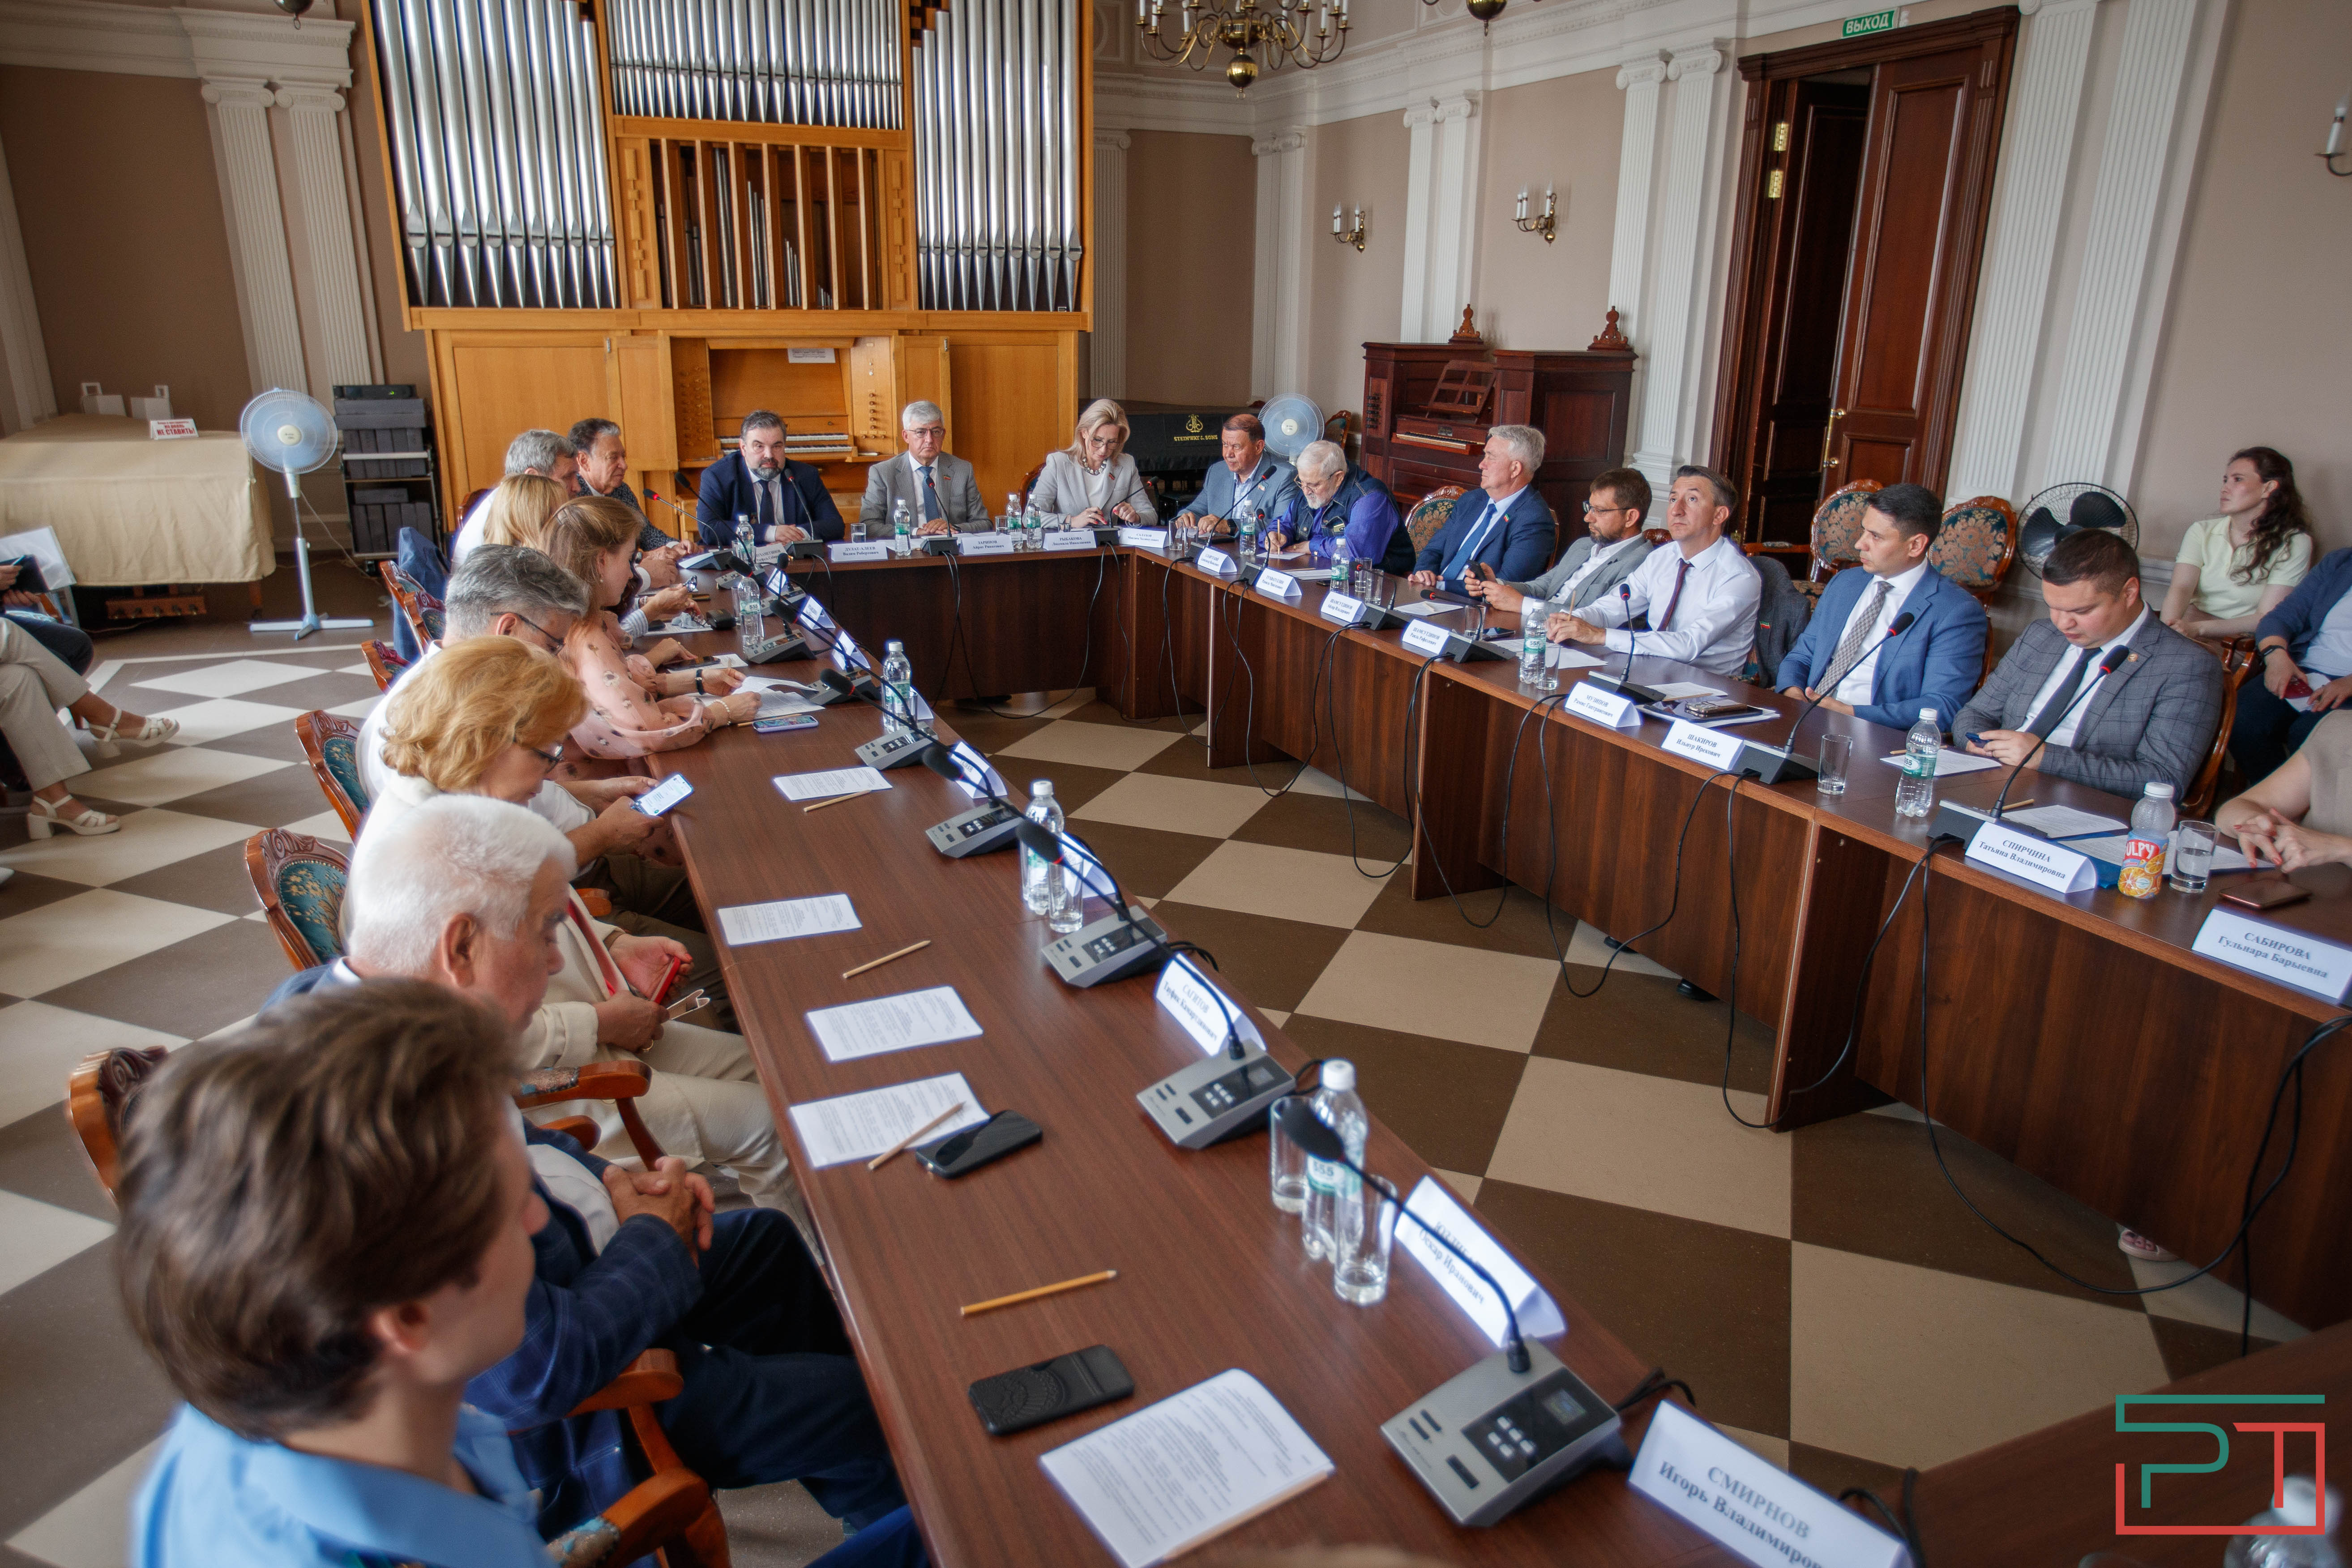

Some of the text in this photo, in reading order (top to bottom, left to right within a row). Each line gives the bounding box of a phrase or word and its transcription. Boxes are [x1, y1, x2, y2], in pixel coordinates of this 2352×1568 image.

[1846, 13, 1889, 34] ВЫХОД
[166, 427, 196, 435] СТАВИТЬ!
[1676, 739, 1721, 758] Ильнур Ирекович
[1687, 733, 1718, 748] ШАКИРОВ
[1978, 841, 2066, 880] Татьяна Владимировна
[2002, 839, 2052, 863] СПИРЧИНА
[2125, 841, 2155, 859] ULPY
[2217, 935, 2328, 978] Гульнара Барыевна
[2244, 931, 2311, 961] САБИРОВА
[1658, 1460, 1708, 1503] Игорь
[1706, 1465, 1812, 1540] СМИРНОВ
